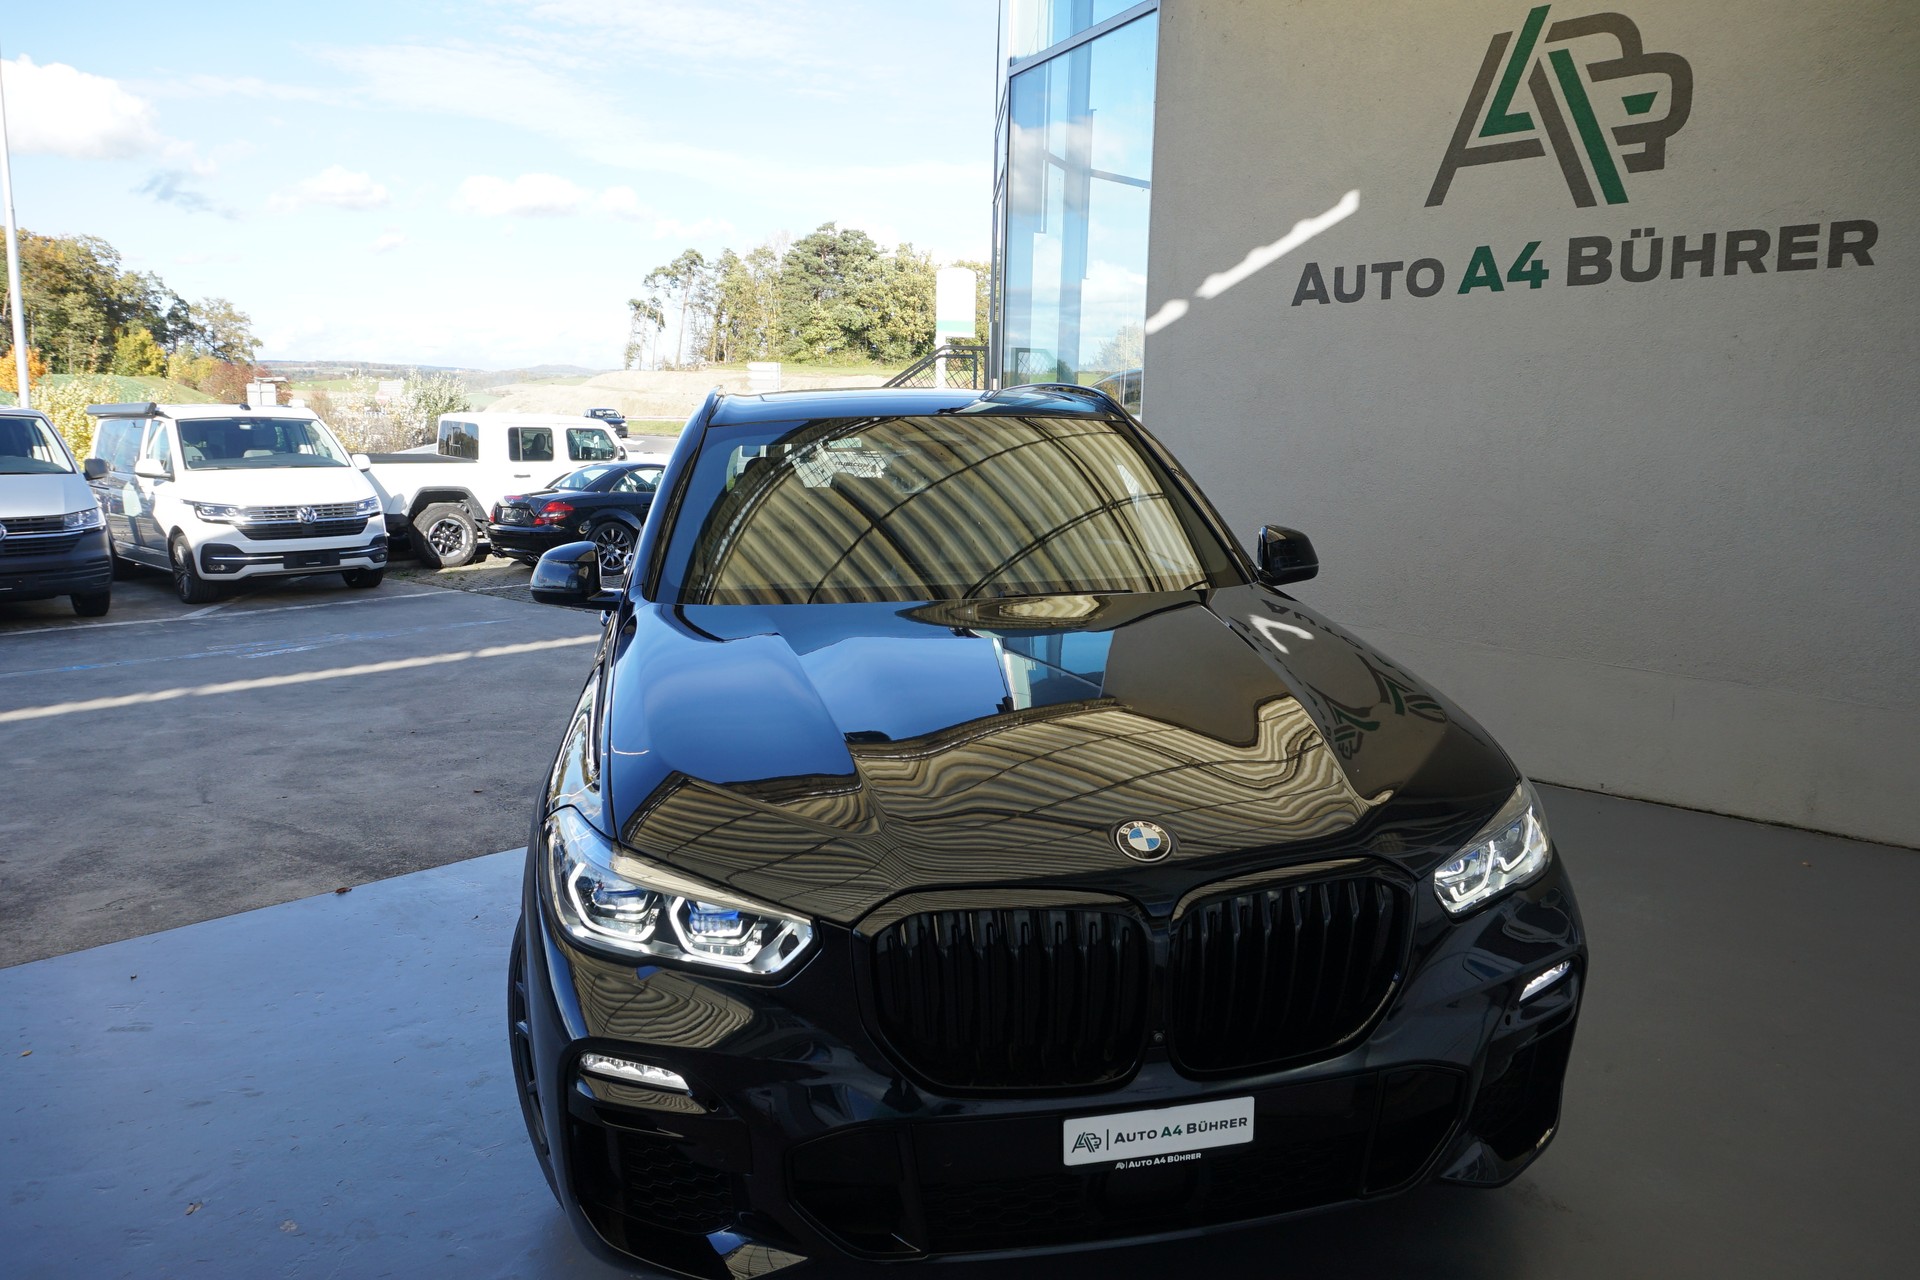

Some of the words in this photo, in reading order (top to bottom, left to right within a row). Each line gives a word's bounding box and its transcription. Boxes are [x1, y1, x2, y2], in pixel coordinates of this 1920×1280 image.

[1291, 258, 1445, 307] AUTO
[1457, 241, 1550, 295] A4
[1567, 219, 1879, 287] BÜHRER
[1120, 821, 1162, 835] BMW
[1114, 1129, 1158, 1144] AUTO
[1160, 1124, 1183, 1138] A4
[1186, 1117, 1248, 1134] BÜHRER
[1128, 1160, 1153, 1168] AUTO
[1153, 1157, 1166, 1165] A4
[1167, 1152, 1202, 1163] BÜHRER
